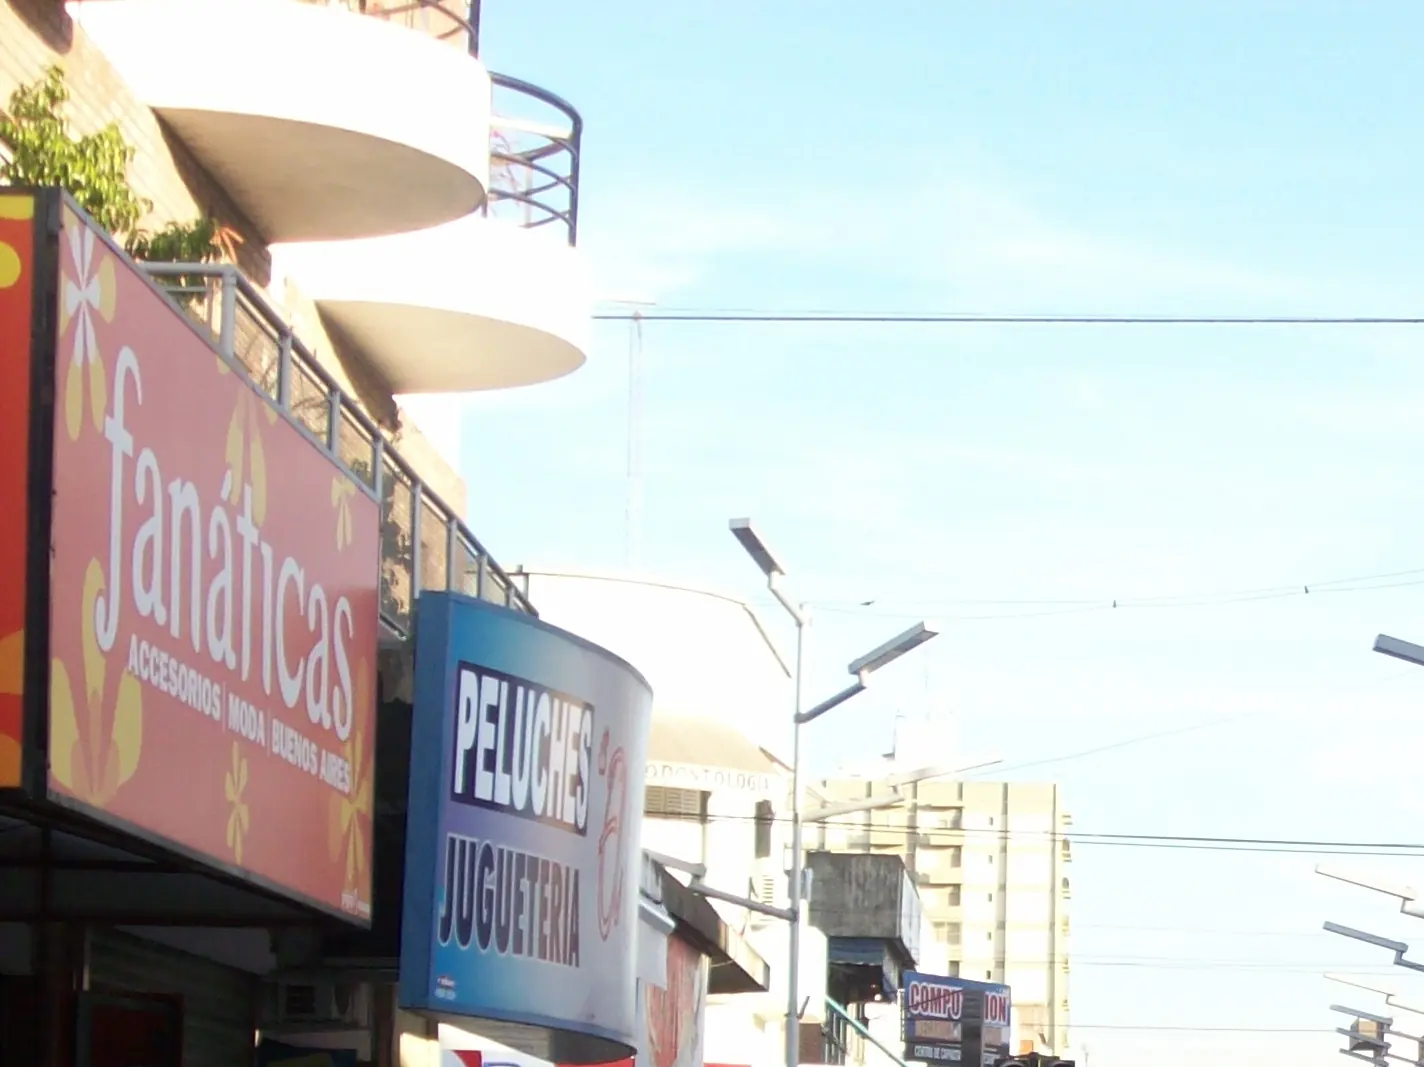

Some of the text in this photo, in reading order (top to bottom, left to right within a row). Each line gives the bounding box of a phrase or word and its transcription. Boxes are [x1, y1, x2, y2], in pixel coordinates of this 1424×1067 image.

[128, 632, 353, 795] ACCESORIOS MODA BUENOS AIRES
[454, 668, 592, 830] PELUCHES
[437, 831, 581, 969] JUGUETERIA
